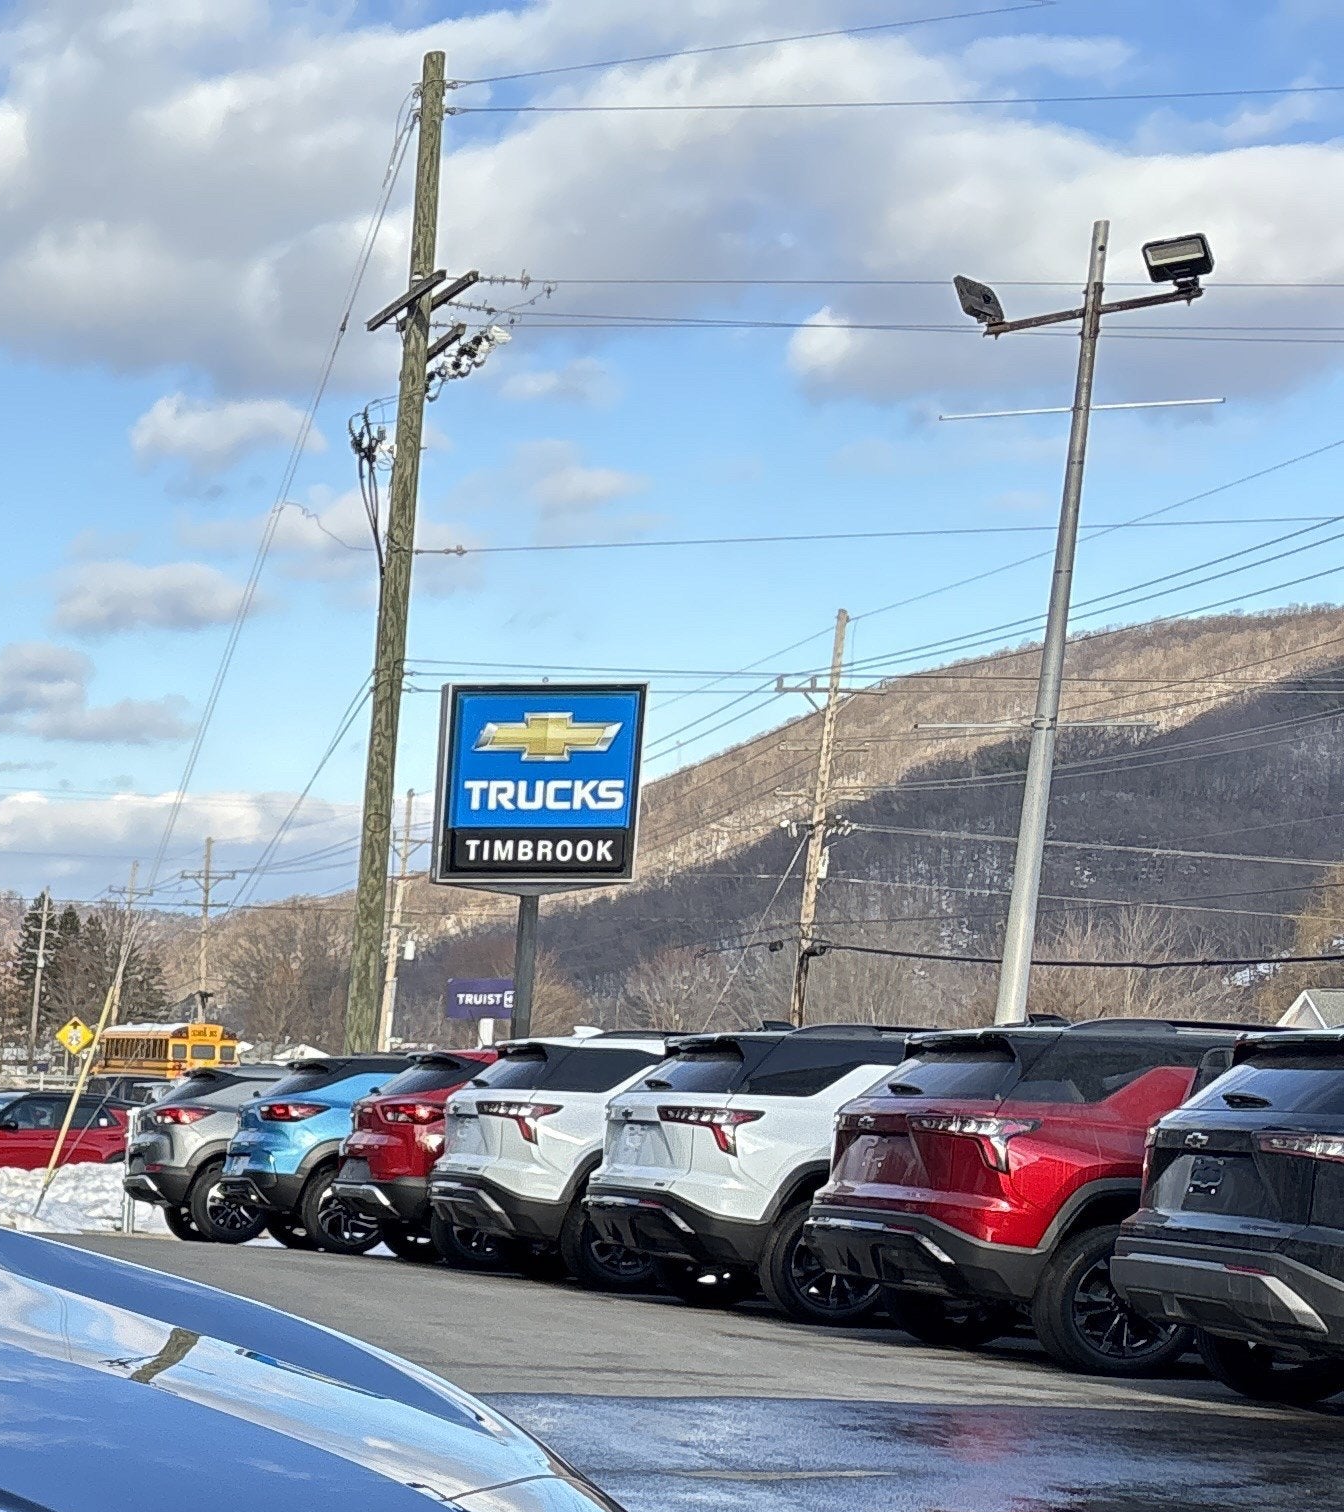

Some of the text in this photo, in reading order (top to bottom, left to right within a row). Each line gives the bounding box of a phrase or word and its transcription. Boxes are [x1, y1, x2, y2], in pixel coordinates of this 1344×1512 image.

[464, 779, 625, 811] TRUCKS
[465, 839, 614, 862] TIMBROOK
[456, 993, 503, 1005] TRUIST
